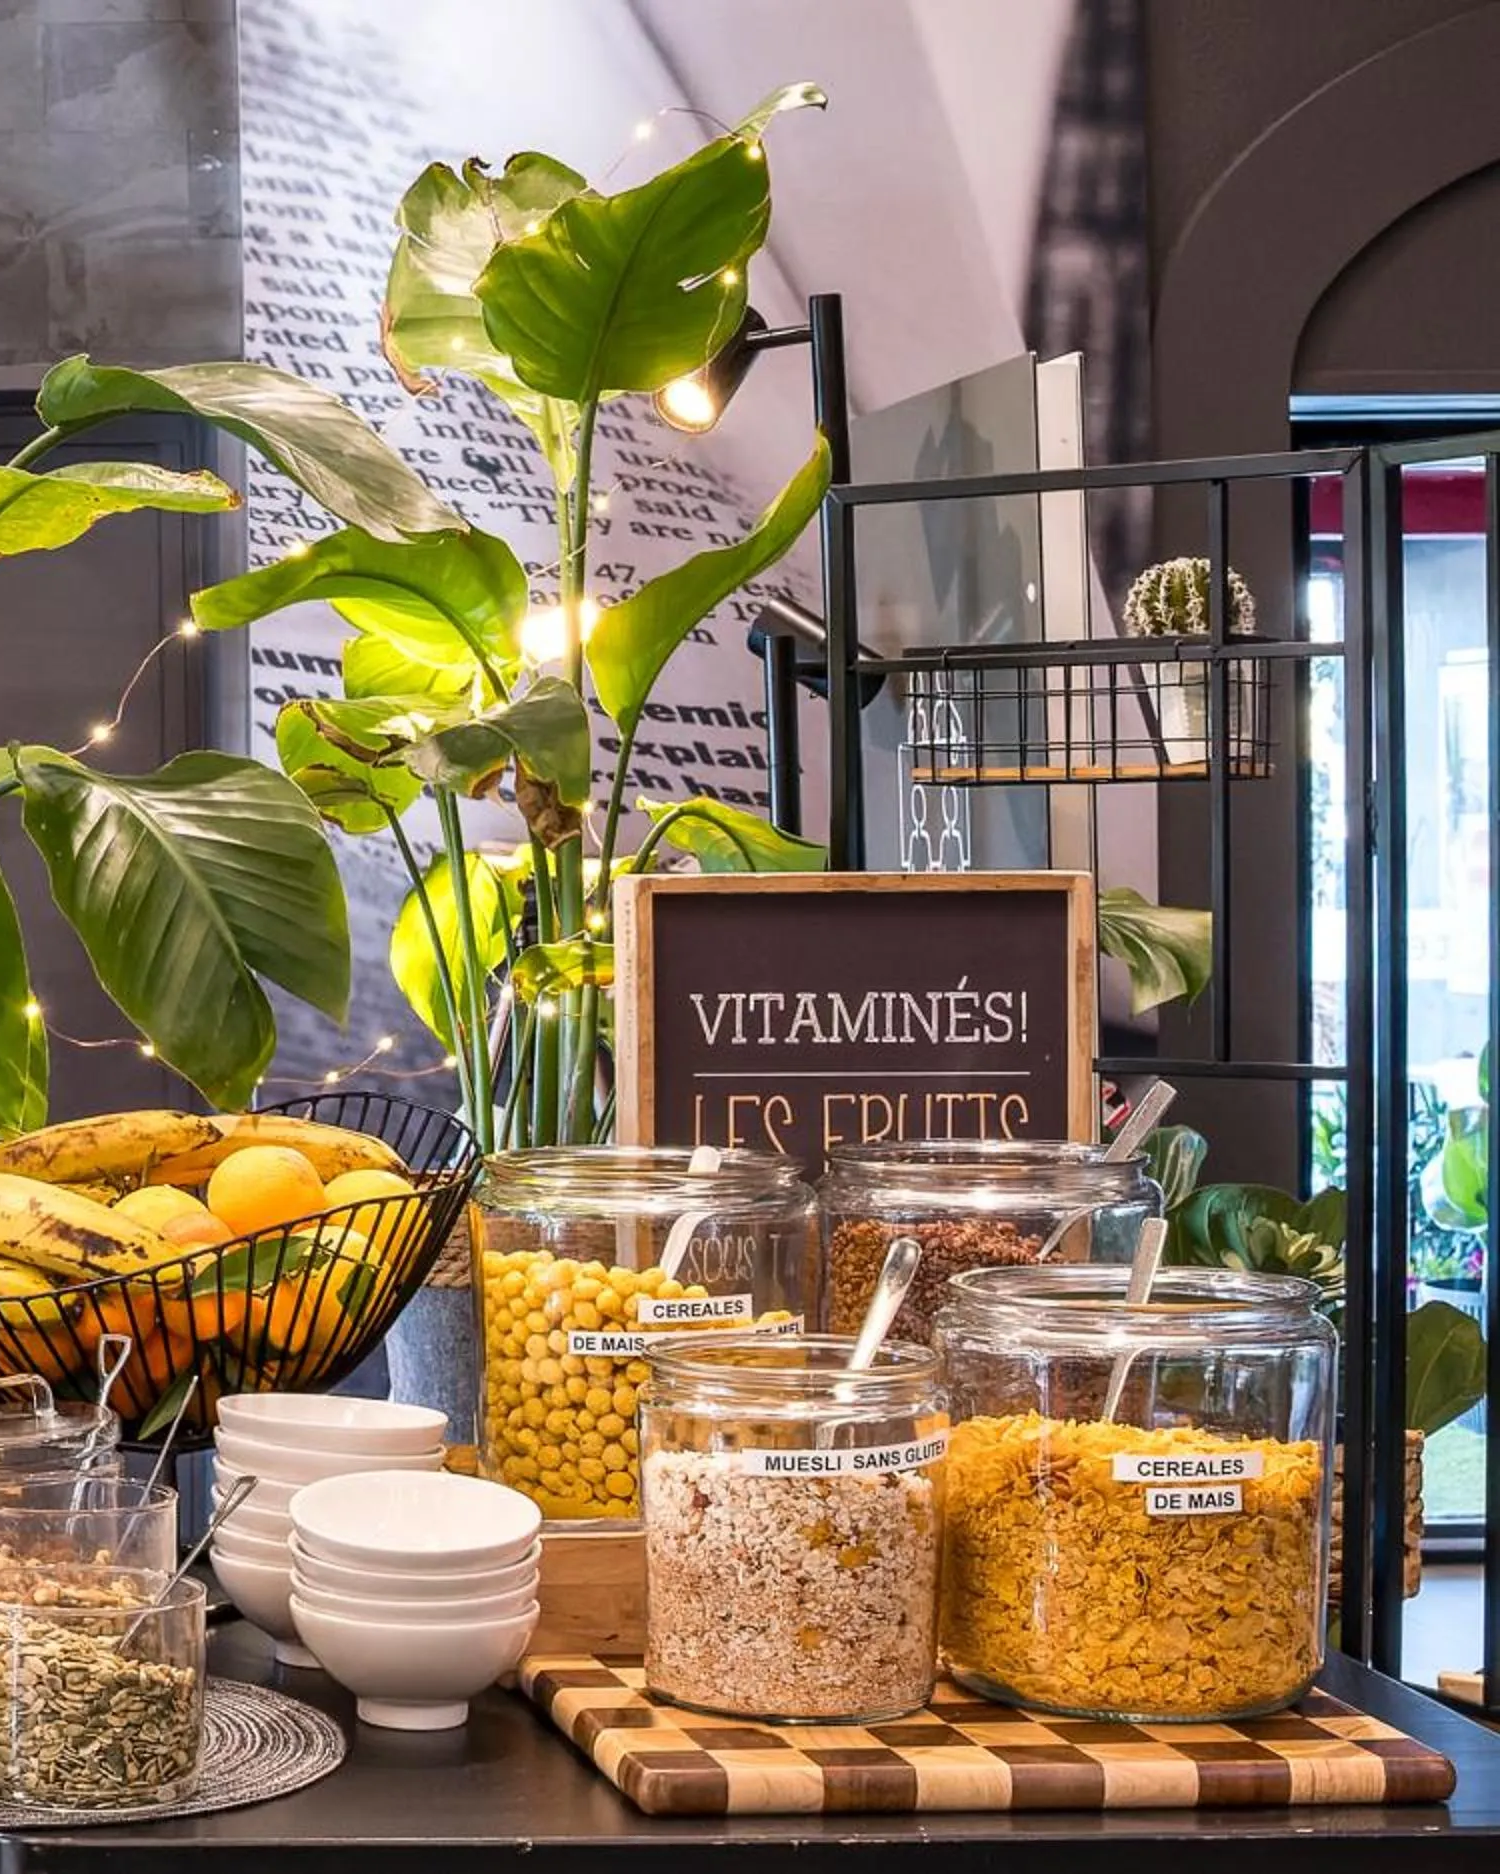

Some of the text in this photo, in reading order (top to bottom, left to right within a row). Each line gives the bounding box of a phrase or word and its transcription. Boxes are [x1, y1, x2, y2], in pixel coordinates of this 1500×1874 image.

[633, 499, 719, 525] said
[629, 520, 694, 543] are
[689, 975, 1029, 1046] VITAMINÉS!
[652, 1300, 745, 1319] CEREALES
[572, 1337, 597, 1351] DE
[601, 1336, 645, 1352] MAIS
[764, 1455, 842, 1472] MUESLI
[852, 1449, 902, 1470] SANS
[1136, 1459, 1246, 1478] CEREALES
[1154, 1491, 1236, 1510] DE MAIS
